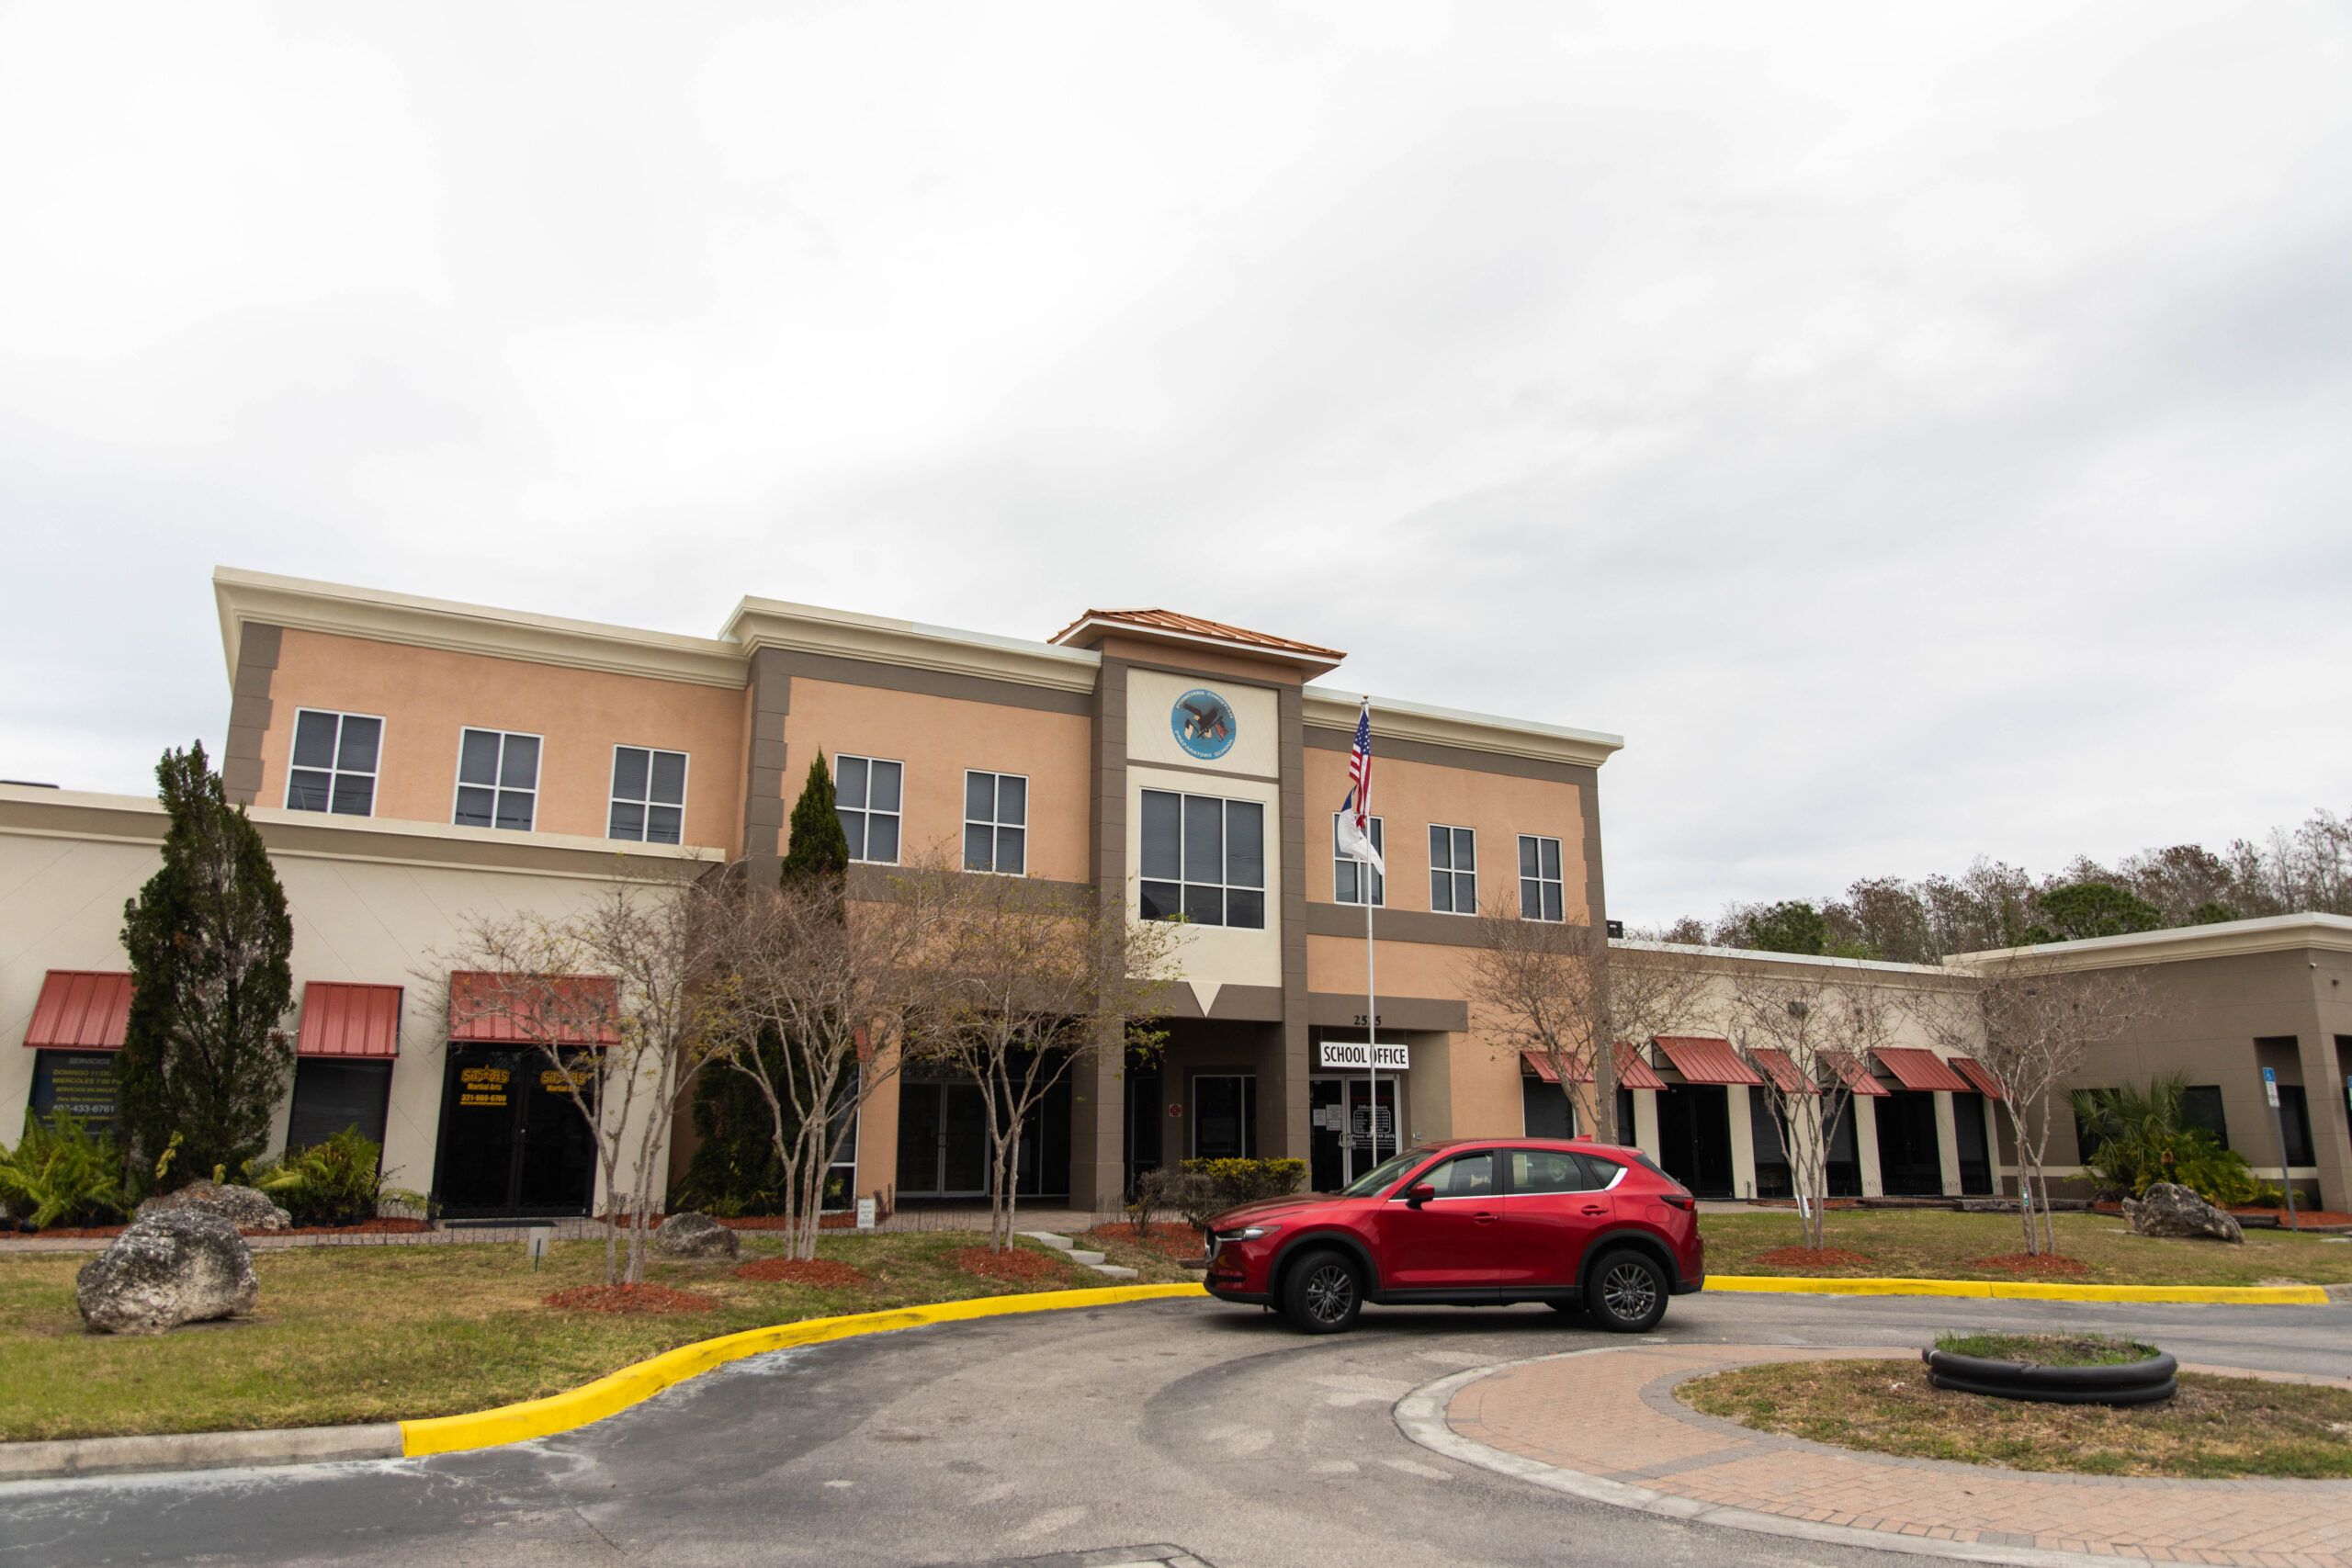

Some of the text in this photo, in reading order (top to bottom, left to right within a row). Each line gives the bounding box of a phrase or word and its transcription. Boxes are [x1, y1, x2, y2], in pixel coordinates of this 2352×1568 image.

[1176, 691, 1234, 719] POINCIANA CHRISTIAN
[1174, 729, 1234, 758] PREPARATORY SCHOOL
[1353, 1015, 1382, 1026] 255
[1324, 1046, 1407, 1064] SCHOOL OFFICE
[490, 1083, 503, 1091] Arts
